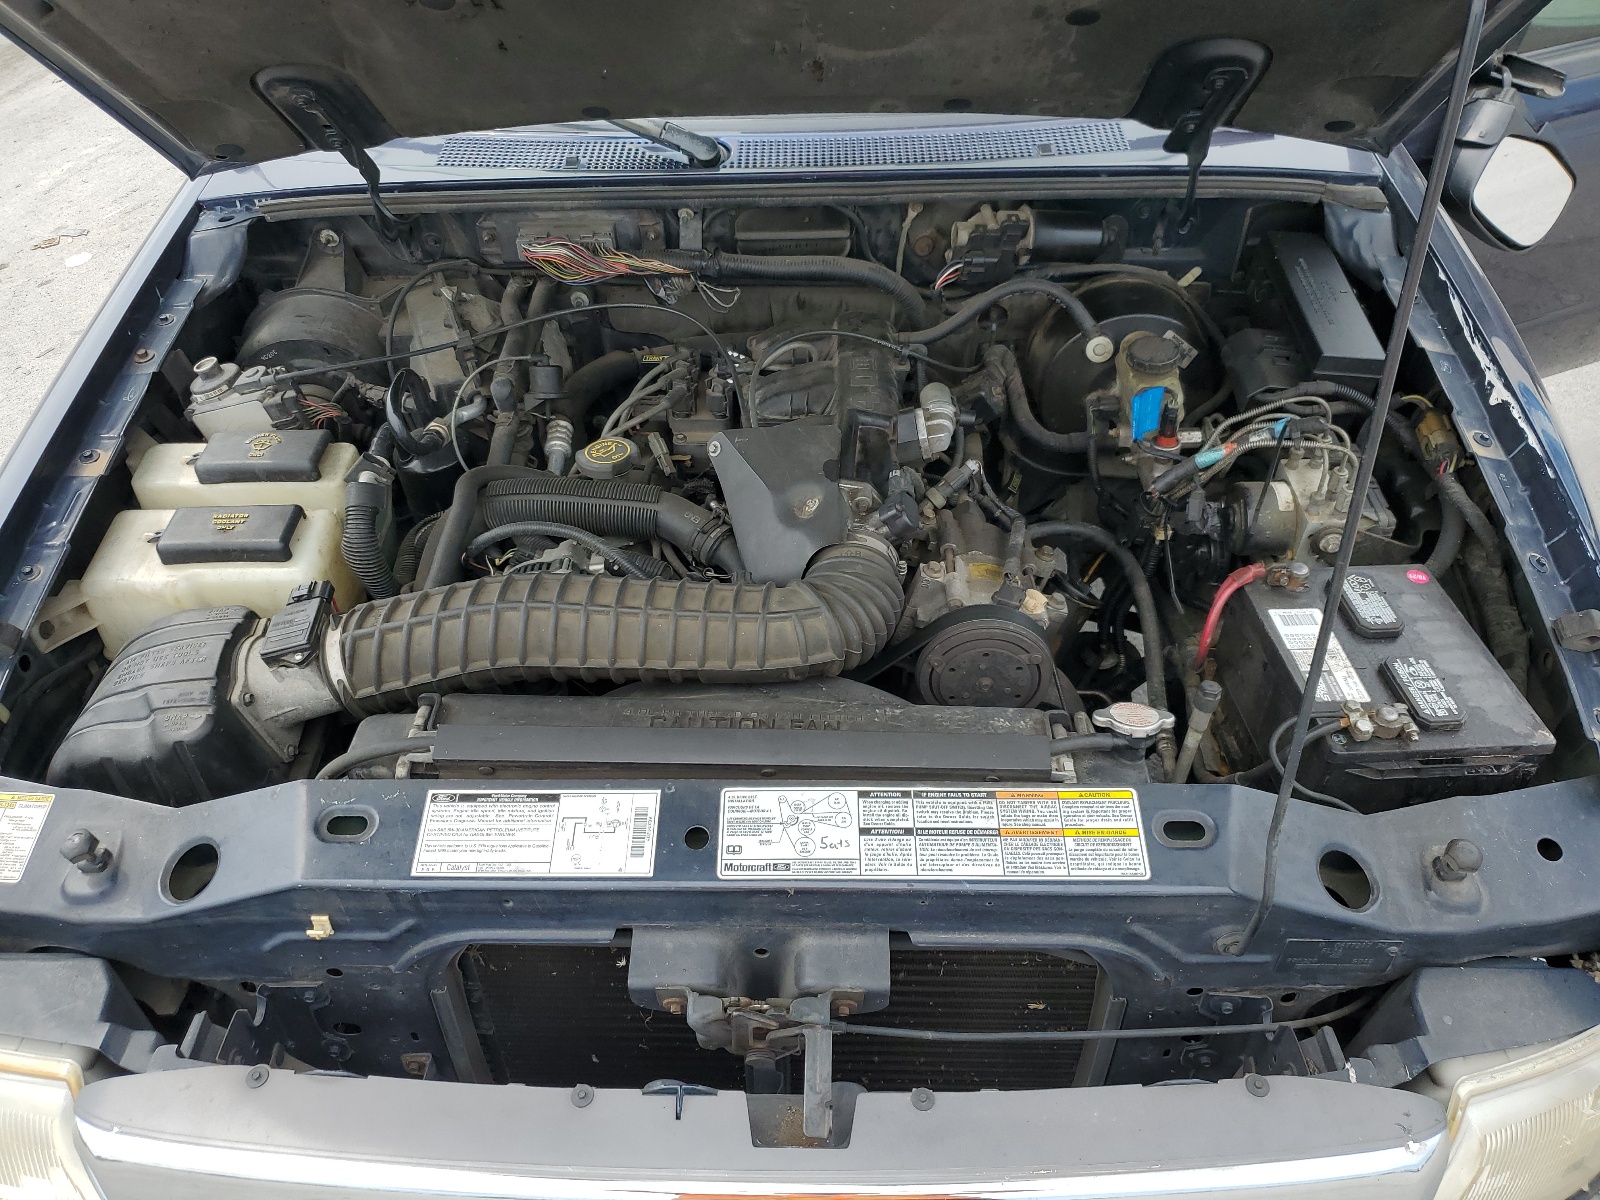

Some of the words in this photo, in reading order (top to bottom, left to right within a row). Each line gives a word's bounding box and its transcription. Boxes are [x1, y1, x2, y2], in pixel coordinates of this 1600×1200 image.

[649, 716, 776, 729] CAUTION
[790, 719, 842, 731] FAN
[724, 863, 772, 872] Motorcraft
